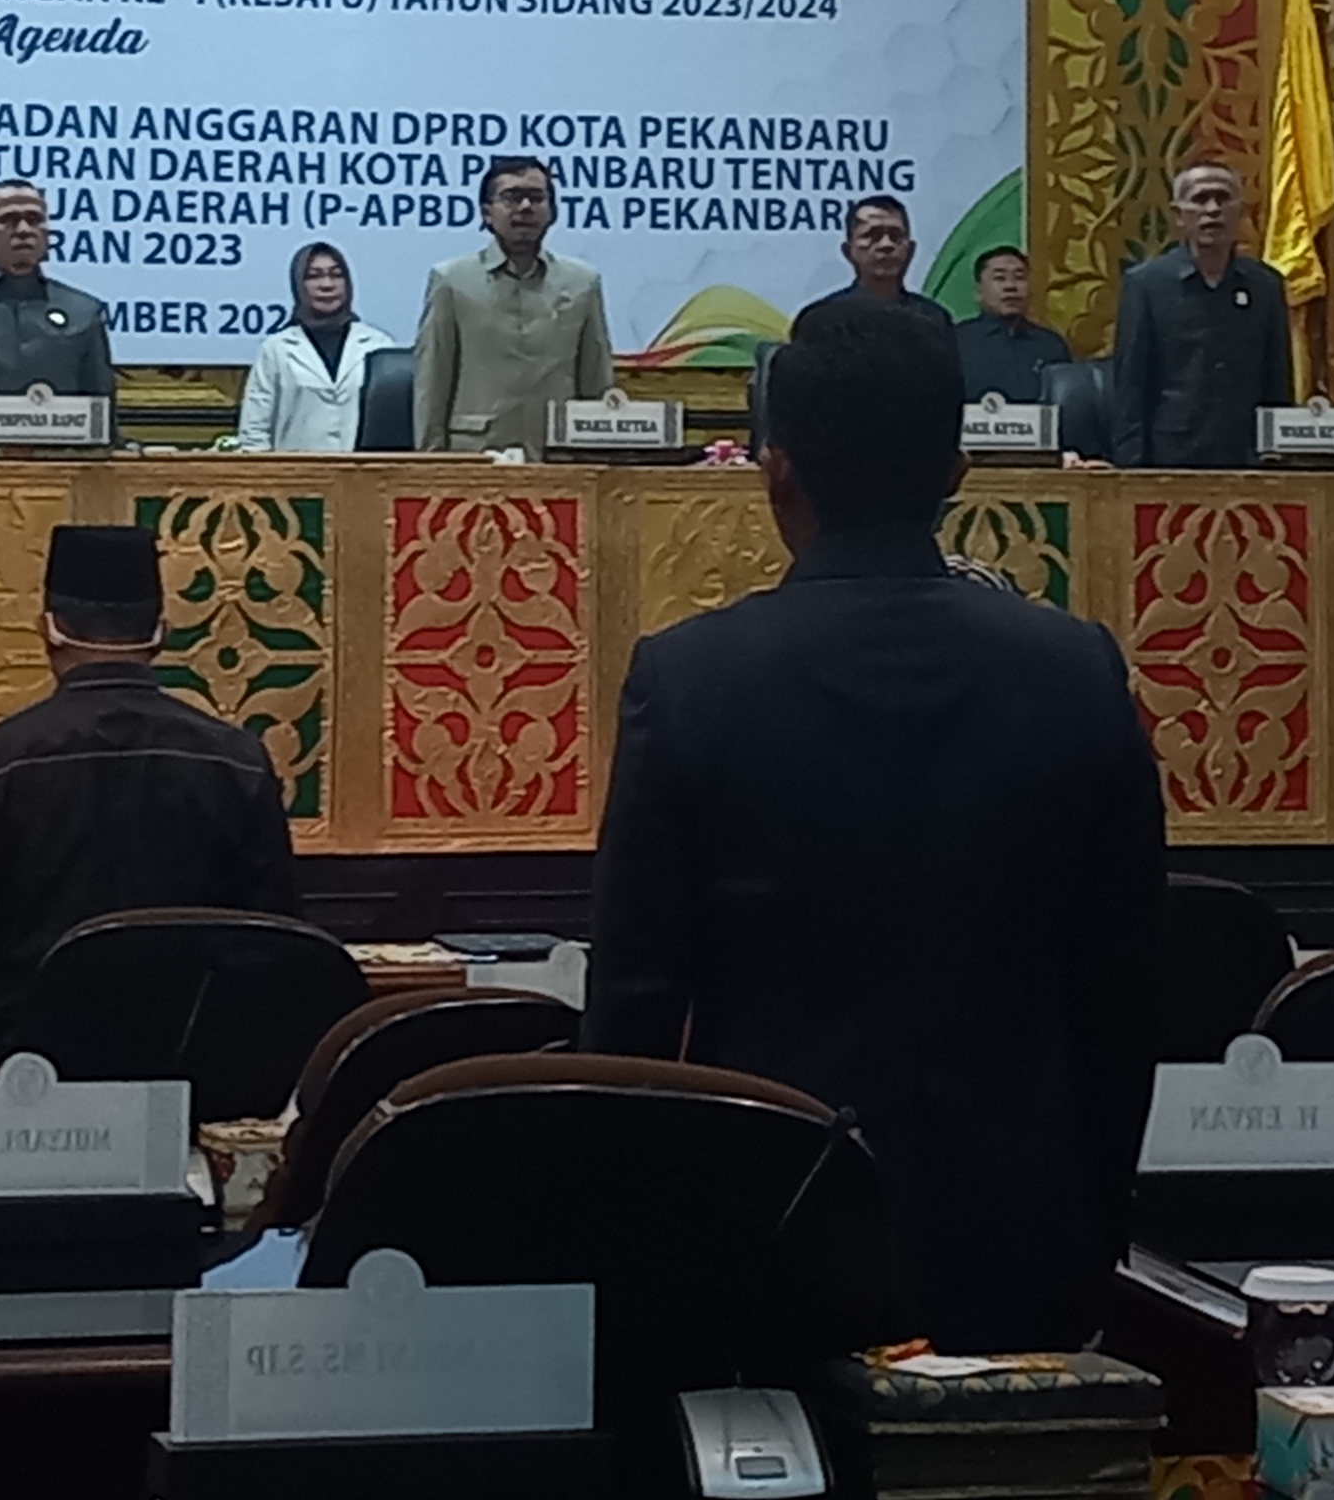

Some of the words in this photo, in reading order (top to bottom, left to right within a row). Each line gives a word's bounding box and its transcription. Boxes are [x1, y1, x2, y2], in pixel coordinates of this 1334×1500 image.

[130, 106, 379, 145] ANGGARAN
[391, 110, 508, 147] DPRD
[520, 114, 626, 149] KOTA
[639, 116, 889, 153] PEKANBARU
[149, 149, 326, 185] DAERAH
[339, 152, 448, 188] KOTA
[461, 154, 715, 190] PANBARU
[725, 157, 915, 192] TENTANG
[112, 189, 288, 226] DAERAH
[622, 197, 855, 232] PEKANBAR
[142, 233, 243, 266] 2023
[218, 303, 289, 335] 202
